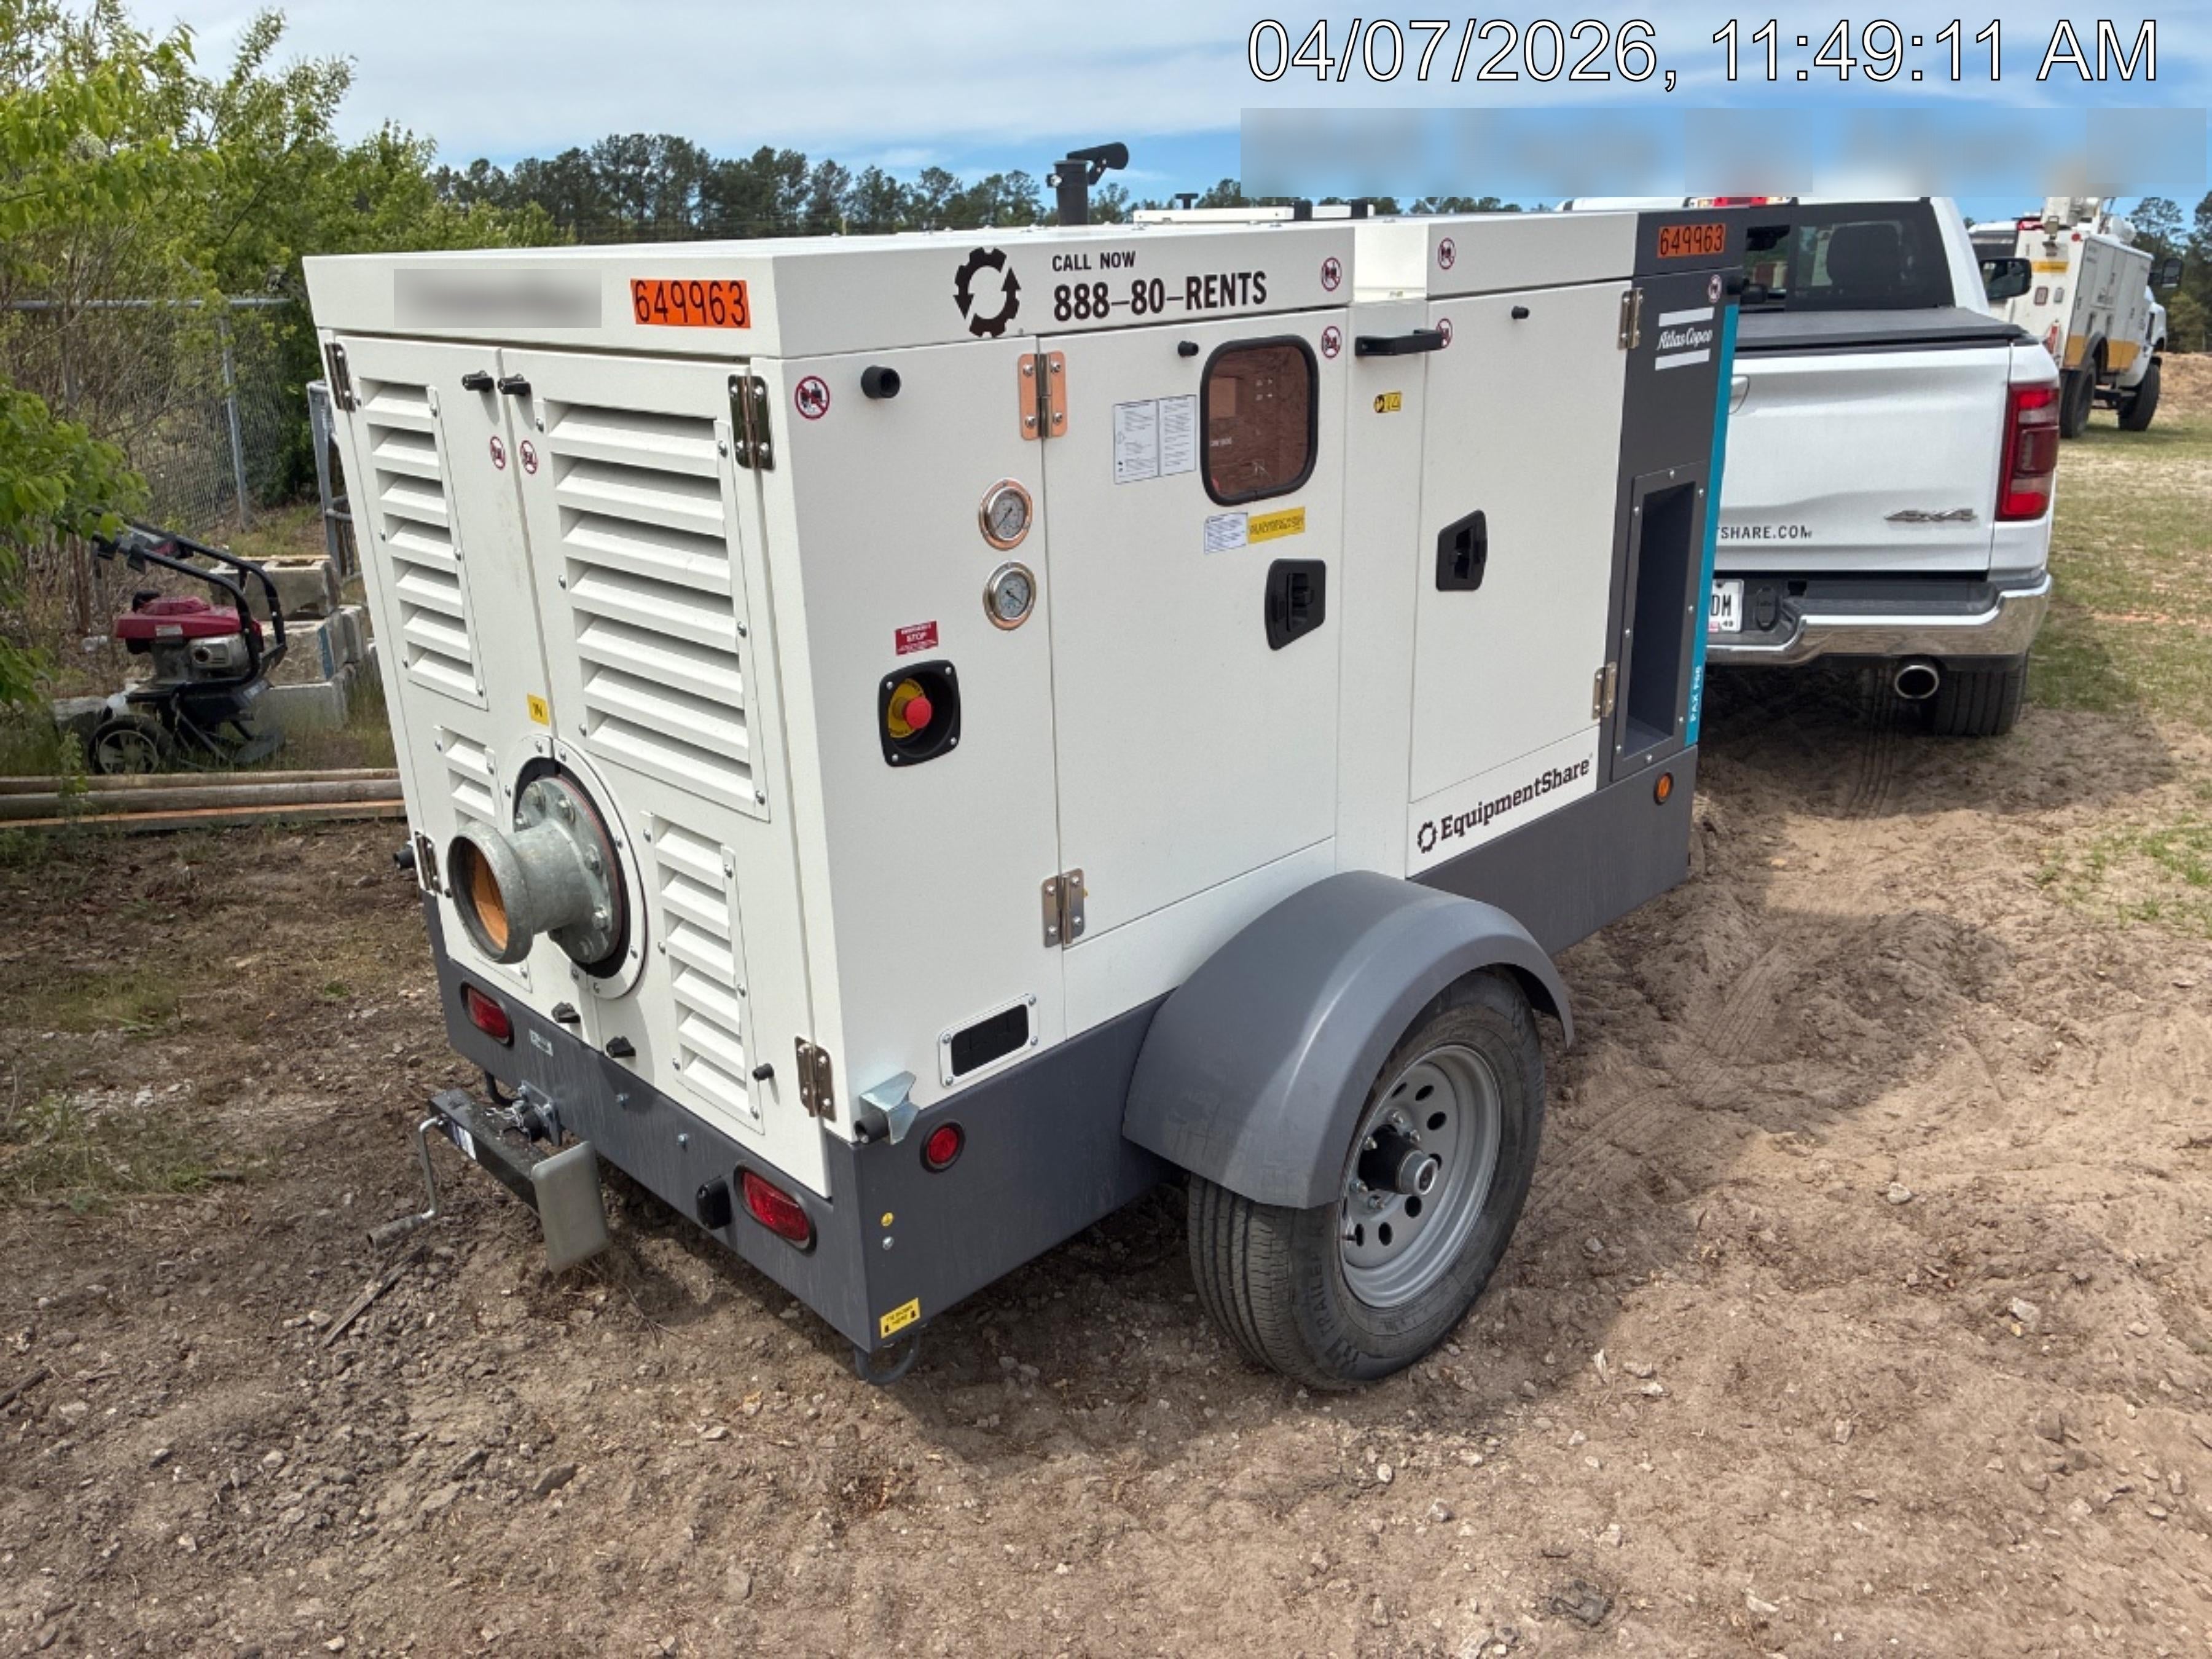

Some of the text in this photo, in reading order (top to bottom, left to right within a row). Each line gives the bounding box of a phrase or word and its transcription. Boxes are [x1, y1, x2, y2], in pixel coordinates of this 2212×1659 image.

[1660, 224, 1724, 256] 649963
[1053, 251, 1135, 272] CALL NOW
[635, 280, 746, 327] 649963
[1440, 758, 1590, 841] EquipmentShare
